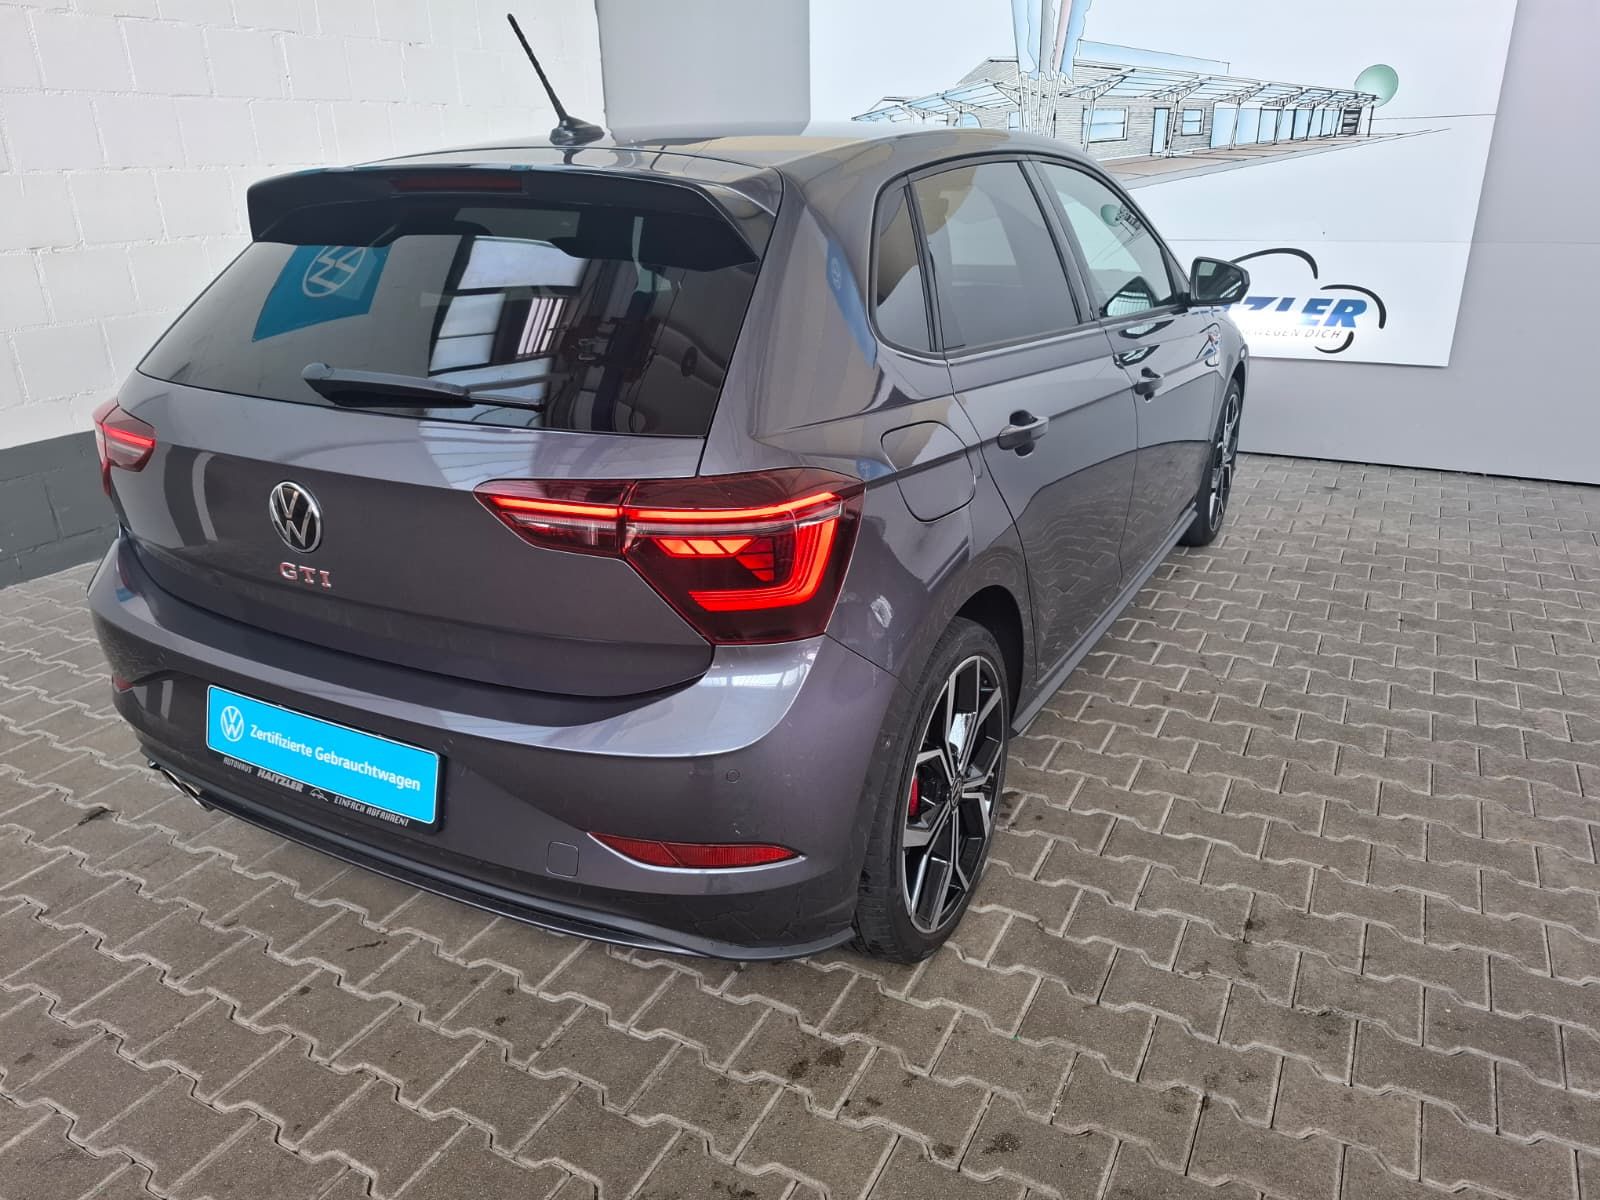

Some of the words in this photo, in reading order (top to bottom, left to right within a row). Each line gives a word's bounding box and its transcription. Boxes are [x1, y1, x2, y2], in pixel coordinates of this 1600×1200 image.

[1304, 328, 1342, 339] DICH
[279, 561, 332, 590] GTI
[250, 724, 312, 758] Zertifizierte
[315, 746, 421, 792] Gebrauchtwagen
[223, 757, 253, 774] AUTOHAUS
[257, 768, 304, 793] HAITZLER
[334, 795, 366, 813] EINFACH
